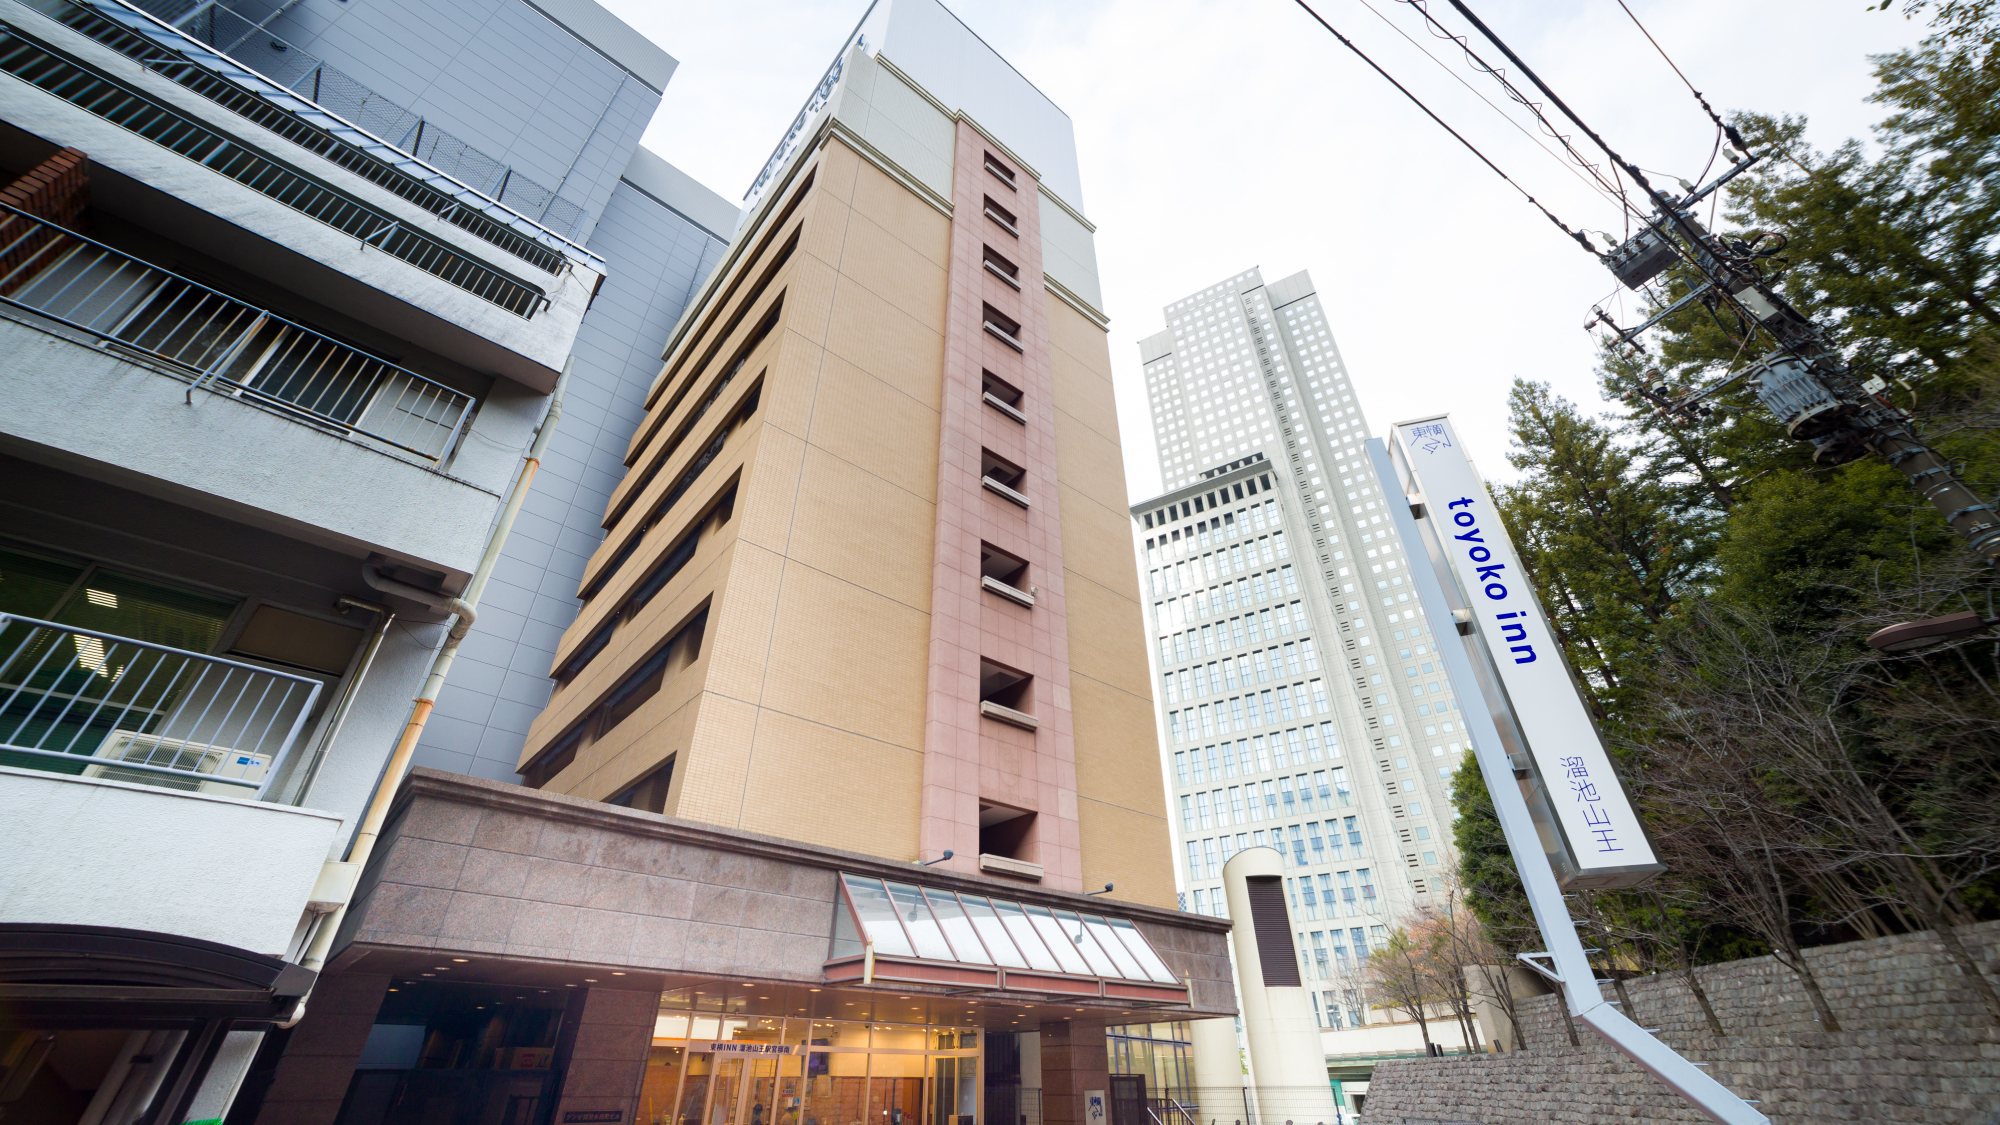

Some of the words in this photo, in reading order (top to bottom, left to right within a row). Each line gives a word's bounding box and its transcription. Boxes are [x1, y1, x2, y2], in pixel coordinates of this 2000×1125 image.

[1448, 497, 1508, 600] toyoko
[1495, 611, 1537, 664] inn
[1560, 756, 1624, 852] 溜池山王
